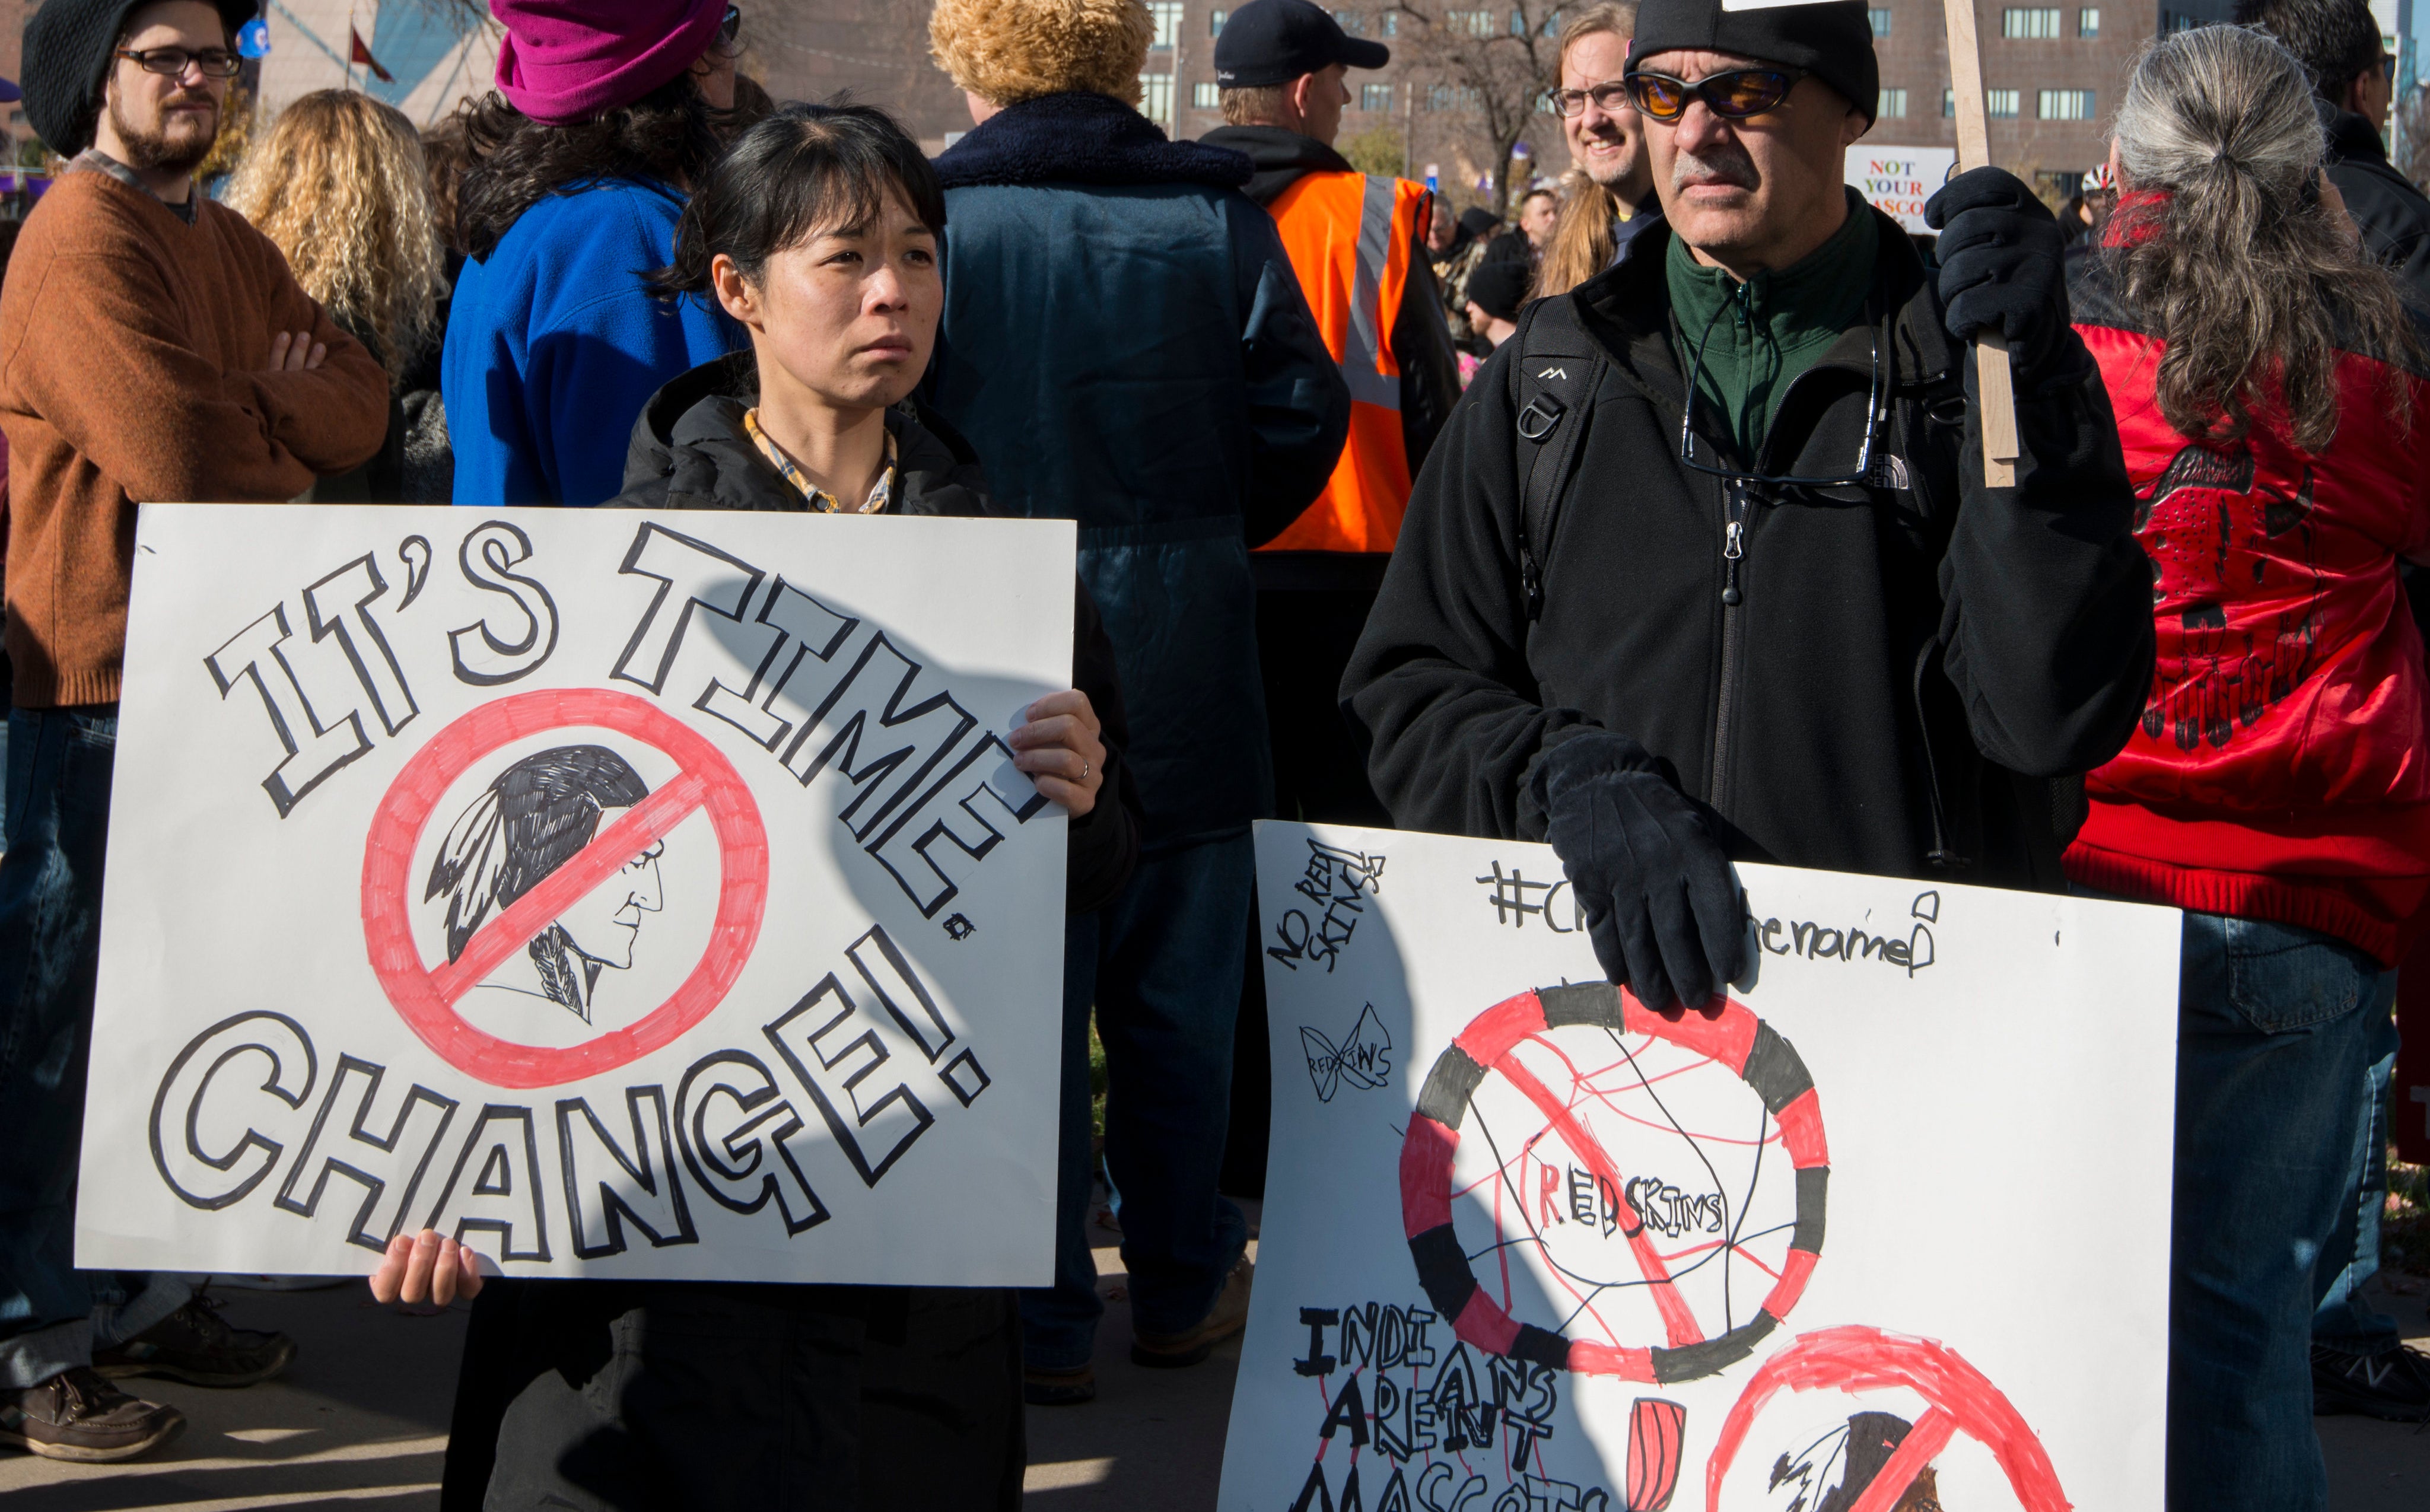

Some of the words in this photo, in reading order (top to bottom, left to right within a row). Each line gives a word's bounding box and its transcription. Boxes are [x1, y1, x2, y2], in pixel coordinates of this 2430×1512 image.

[1865, 179, 1923, 196] YOUR
[1870, 160, 1916, 176] NOT
[203, 520, 559, 819] IT'S
[610, 521, 1051, 941] TIME.
[1267, 909, 1310, 971] NO
[1294, 852, 1332, 906] RED
[148, 924, 991, 1262] CHANGE!
